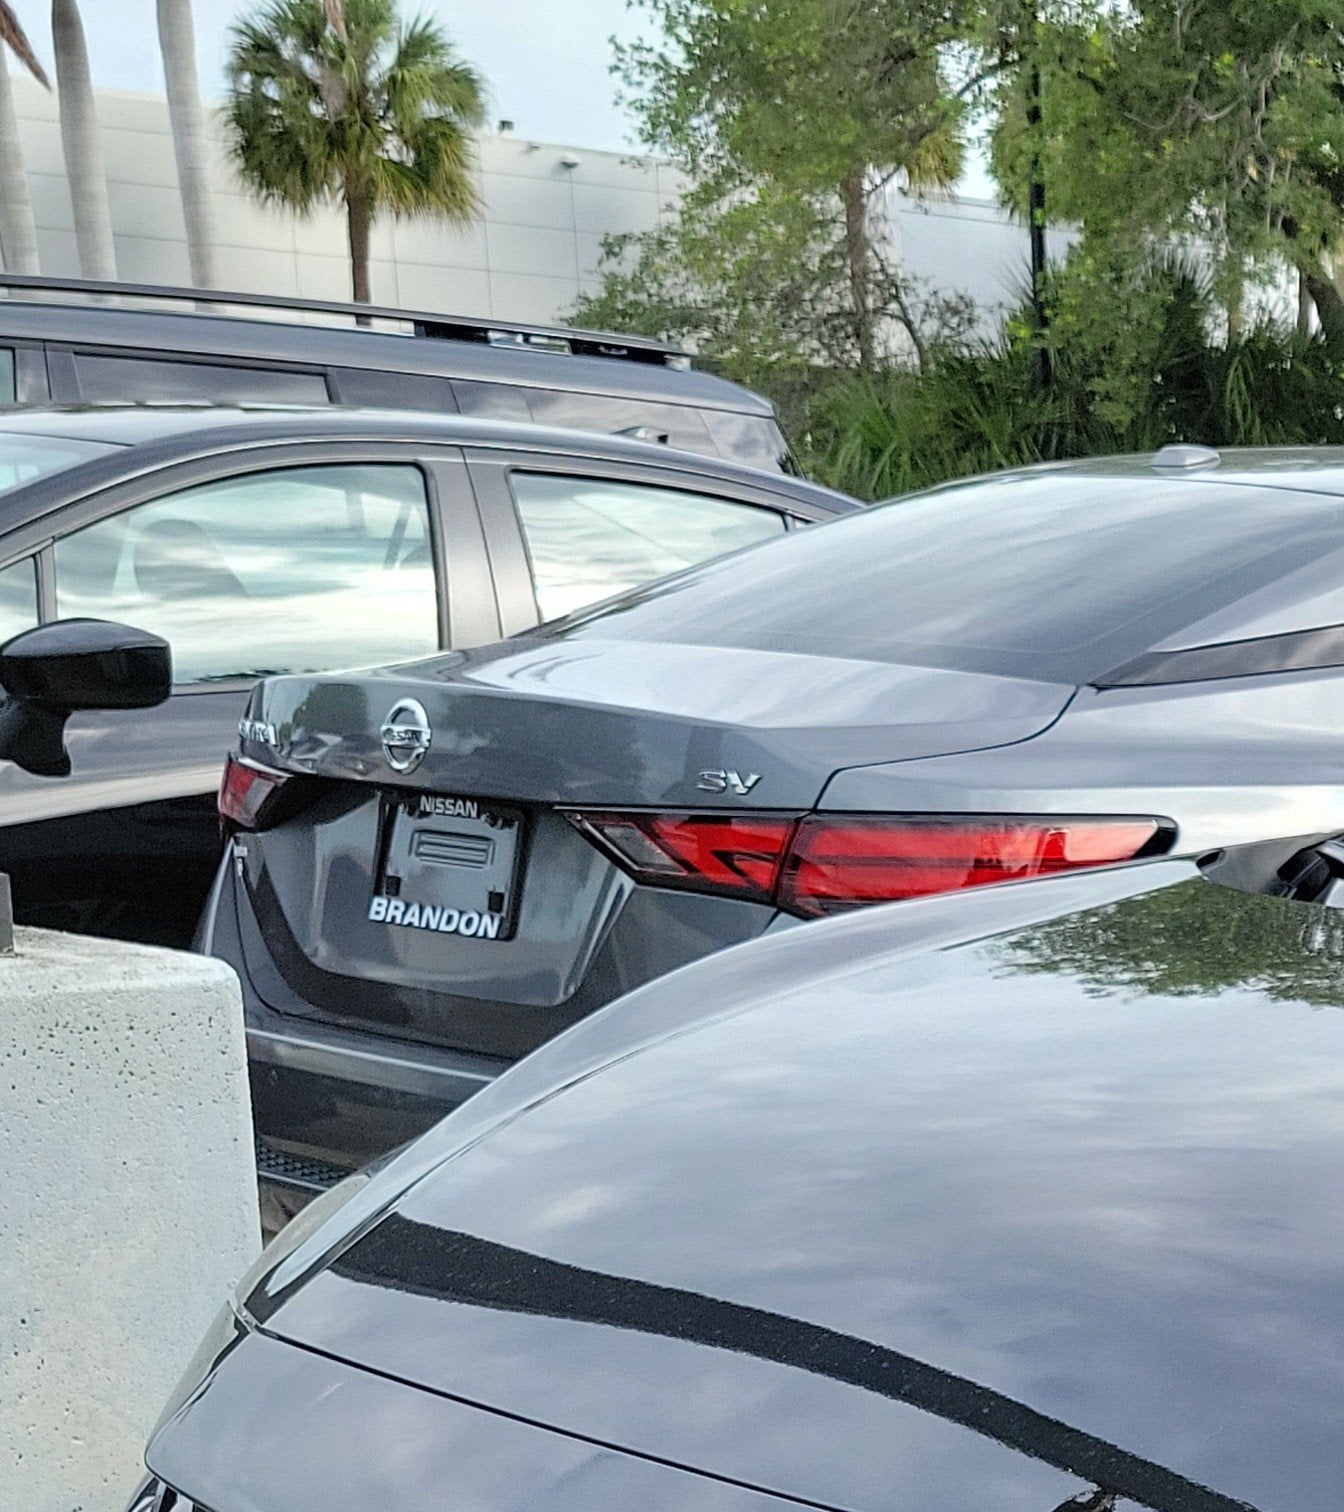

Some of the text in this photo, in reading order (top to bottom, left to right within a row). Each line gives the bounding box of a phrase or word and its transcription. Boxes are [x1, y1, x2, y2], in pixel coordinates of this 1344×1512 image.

[697, 769, 763, 795] SV
[419, 795, 478, 819] NISSAN
[368, 894, 502, 940] BRANDON
